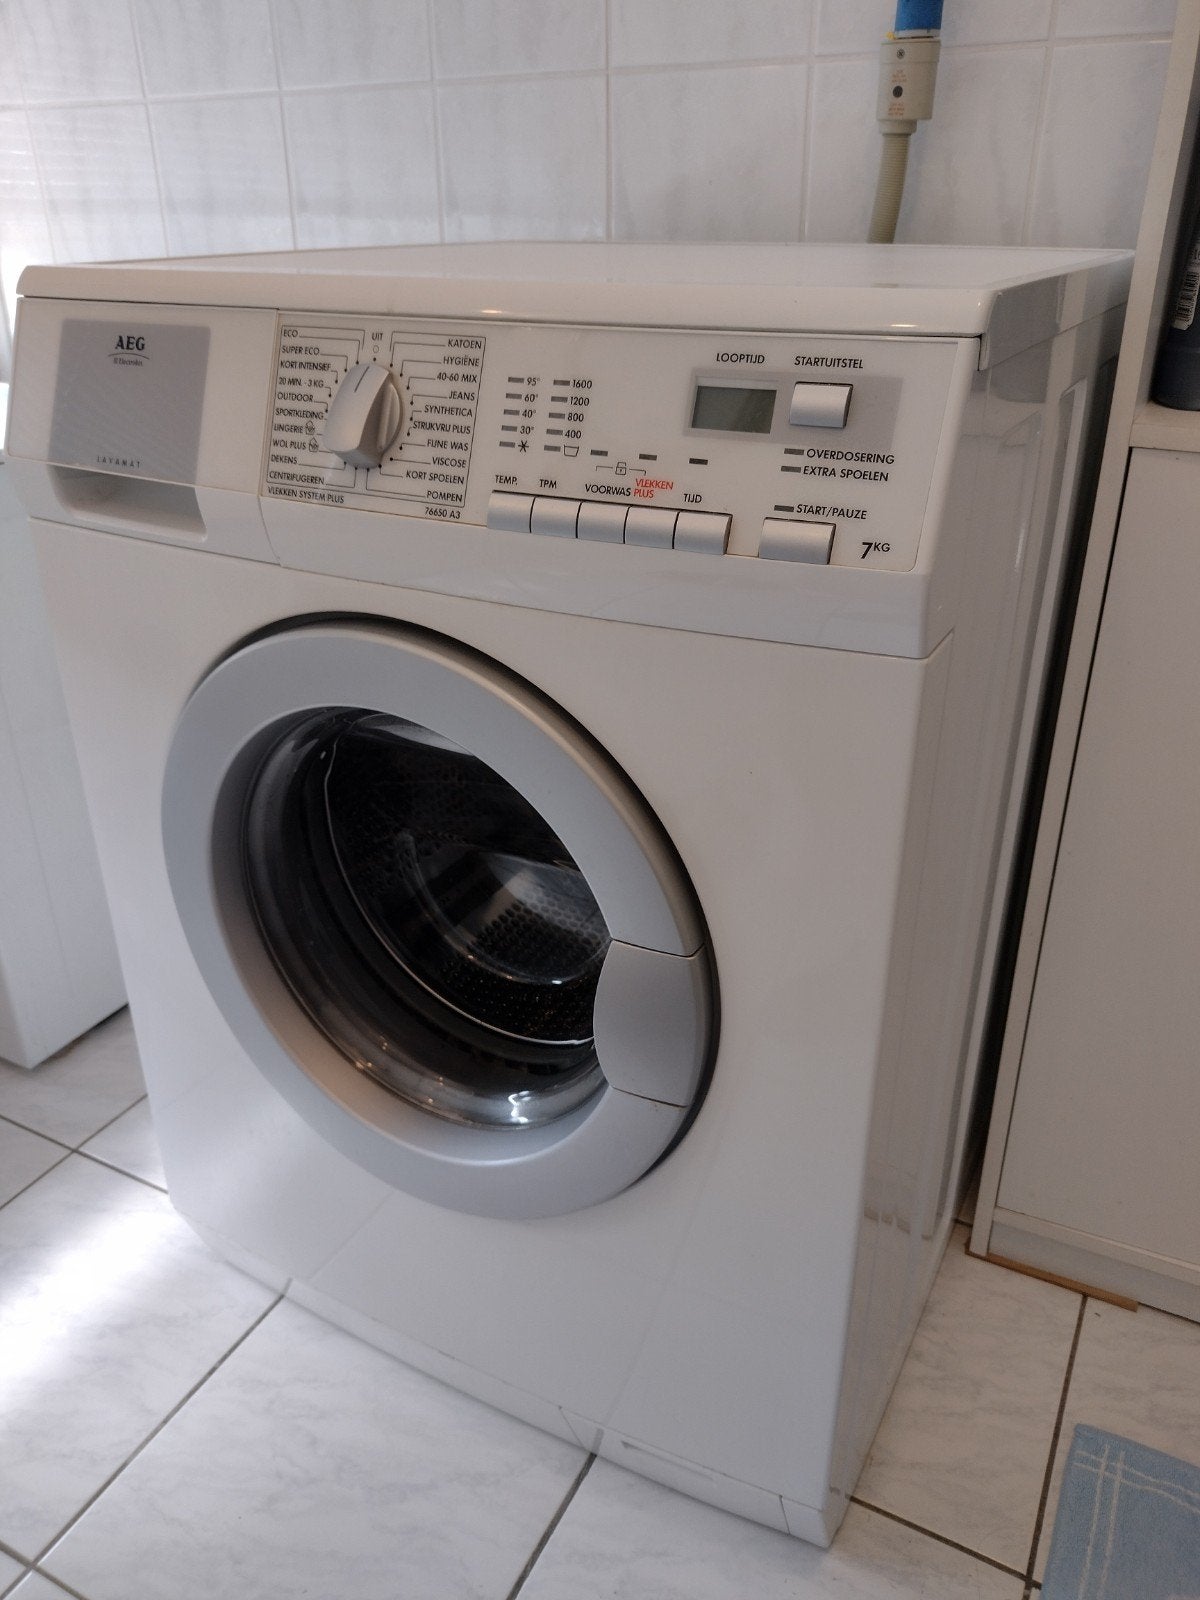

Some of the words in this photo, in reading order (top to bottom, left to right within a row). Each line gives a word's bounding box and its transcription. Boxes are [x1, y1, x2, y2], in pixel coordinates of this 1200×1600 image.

[115, 336, 145, 351] AEG
[448, 339, 482, 349] KATOEN
[282, 346, 303, 354] SUPER
[443, 355, 480, 367] HYGIËNE
[716, 353, 765, 364] LOOPTIJD
[794, 356, 864, 369] STARTUITSTEL
[280, 360, 298, 369] KORT
[299, 362, 331, 371] INTENSIEF
[437, 372, 459, 381] 40-60
[461, 374, 477, 383] MIX
[314, 380, 324, 388] KG
[572, 380, 592, 389] 1600
[277, 392, 314, 402] OUTDOOR
[449, 391, 475, 401] JEANS
[570, 396, 590, 406] 1200
[275, 408, 324, 420] SPORTKLEDING
[424, 405, 472, 417] SYNTHETICA
[568, 413, 584, 422] 800
[274, 424, 303, 433] LINGERIE
[452, 424, 471, 434] PLUS
[564, 430, 582, 439] 400
[273, 439, 288, 448] WOL
[289, 441, 306, 450] PLUS
[450, 442, 469, 452] WAS
[271, 454, 298, 464] DEKENS
[806, 448, 895, 464] OVERDOSERING
[432, 457, 467, 468] VISCOSE
[269, 471, 324, 484] CENTRIFUGEREN
[406, 470, 427, 480] KORT
[428, 473, 464, 484] SPOELEN
[803, 466, 836, 477] EXTRA
[840, 468, 889, 482] SPOELEN
[495, 475, 518, 486] TEMP.
[540, 479, 557, 489] TPM
[636, 478, 673, 490] VLEKKEN
[268, 486, 297, 497] VLEKKEN
[300, 490, 325, 501] SYSTEM
[327, 494, 344, 504] PLUS
[427, 490, 463, 502] POMPEN
[585, 484, 631, 497] VOORWAS
[634, 488, 654, 498] PLUS
[684, 493, 702, 503] TIJD
[425, 507, 447, 518] 76650
[449, 510, 461, 519] A3
[796, 504, 867, 519] START/PAUZE
